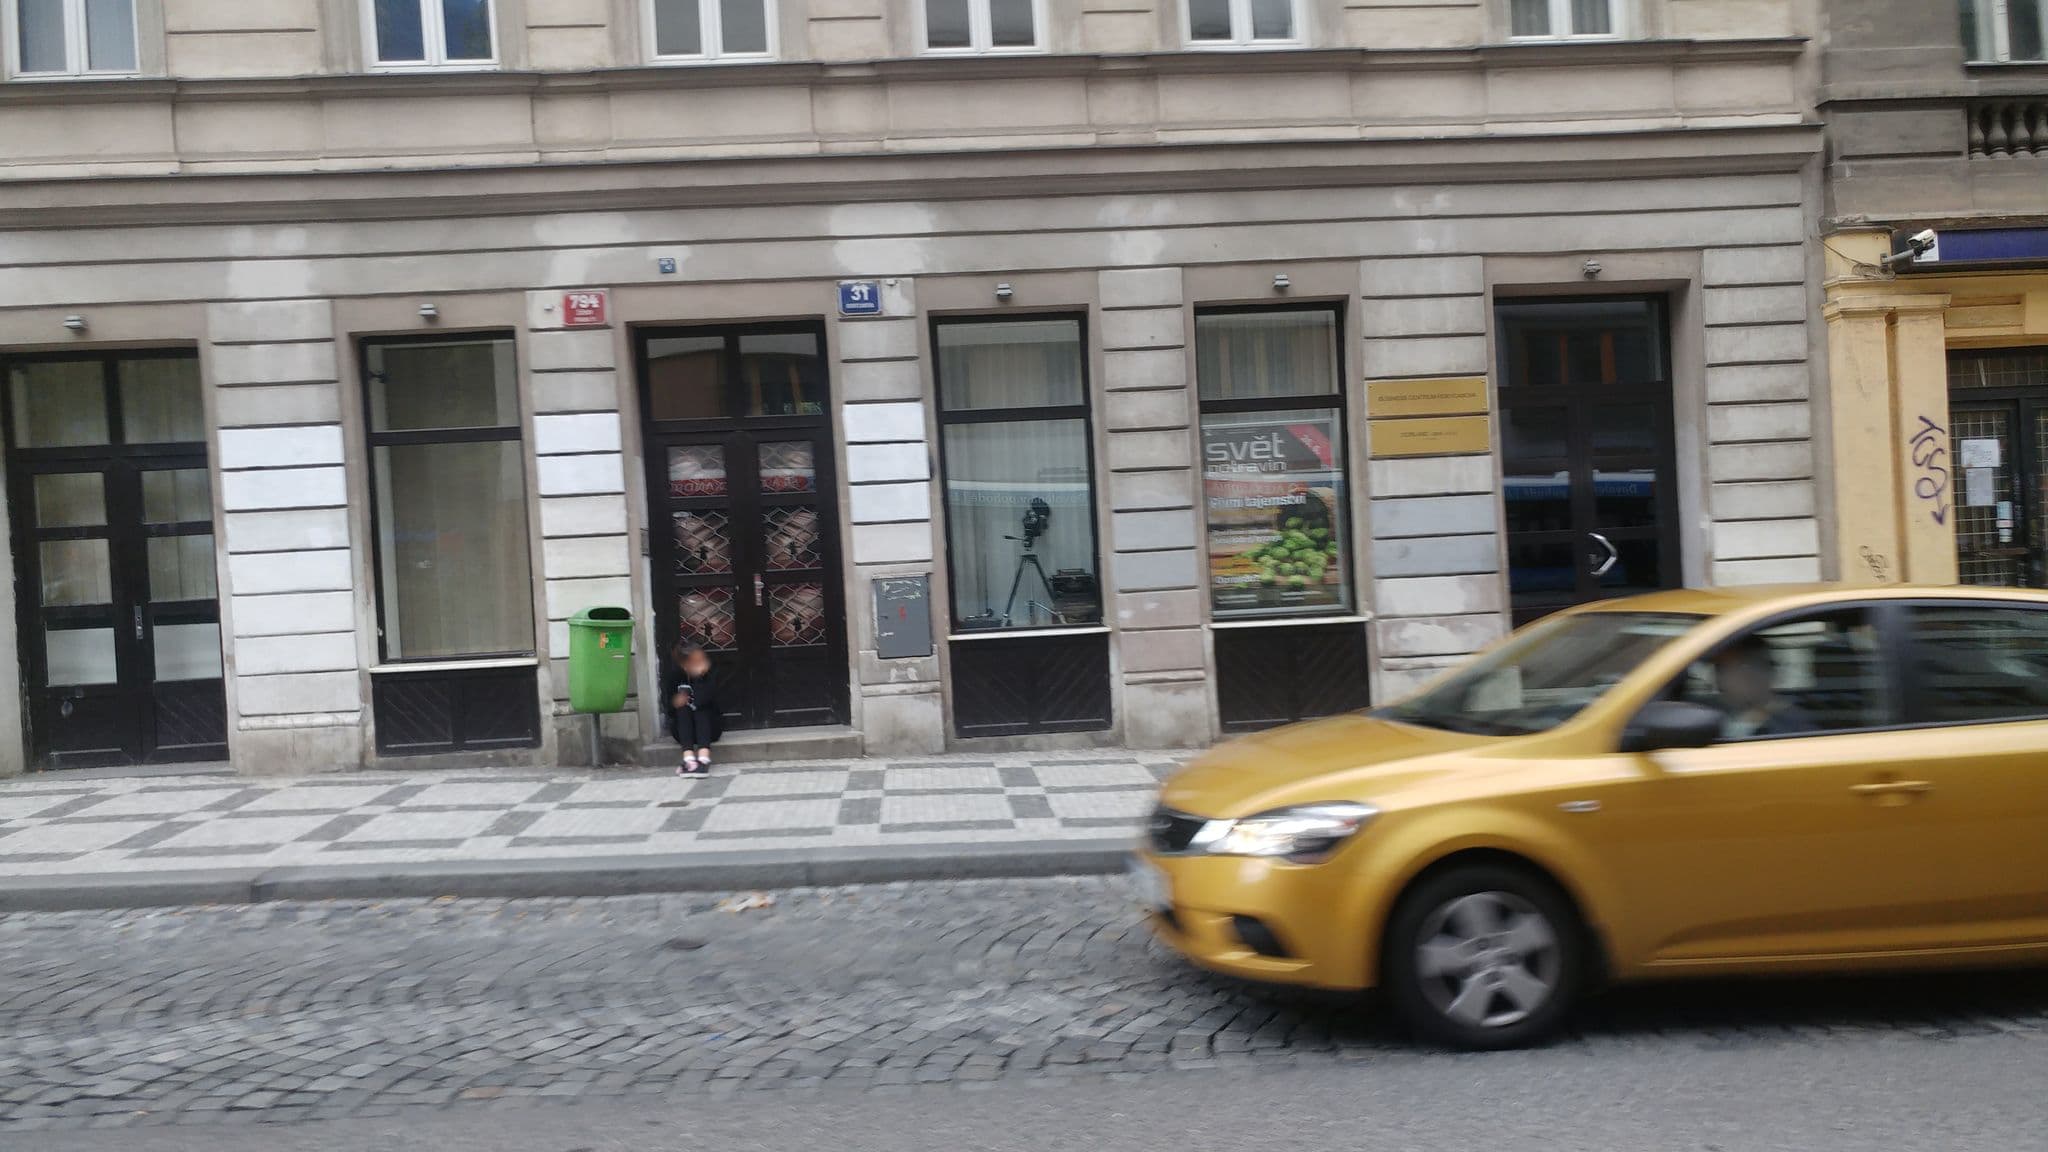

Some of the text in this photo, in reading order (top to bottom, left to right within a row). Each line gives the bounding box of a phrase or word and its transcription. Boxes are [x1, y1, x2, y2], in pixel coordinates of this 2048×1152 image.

[850, 285, 870, 301] 31
[1205, 432, 1286, 461] svět
[1206, 459, 1288, 474] potravin
